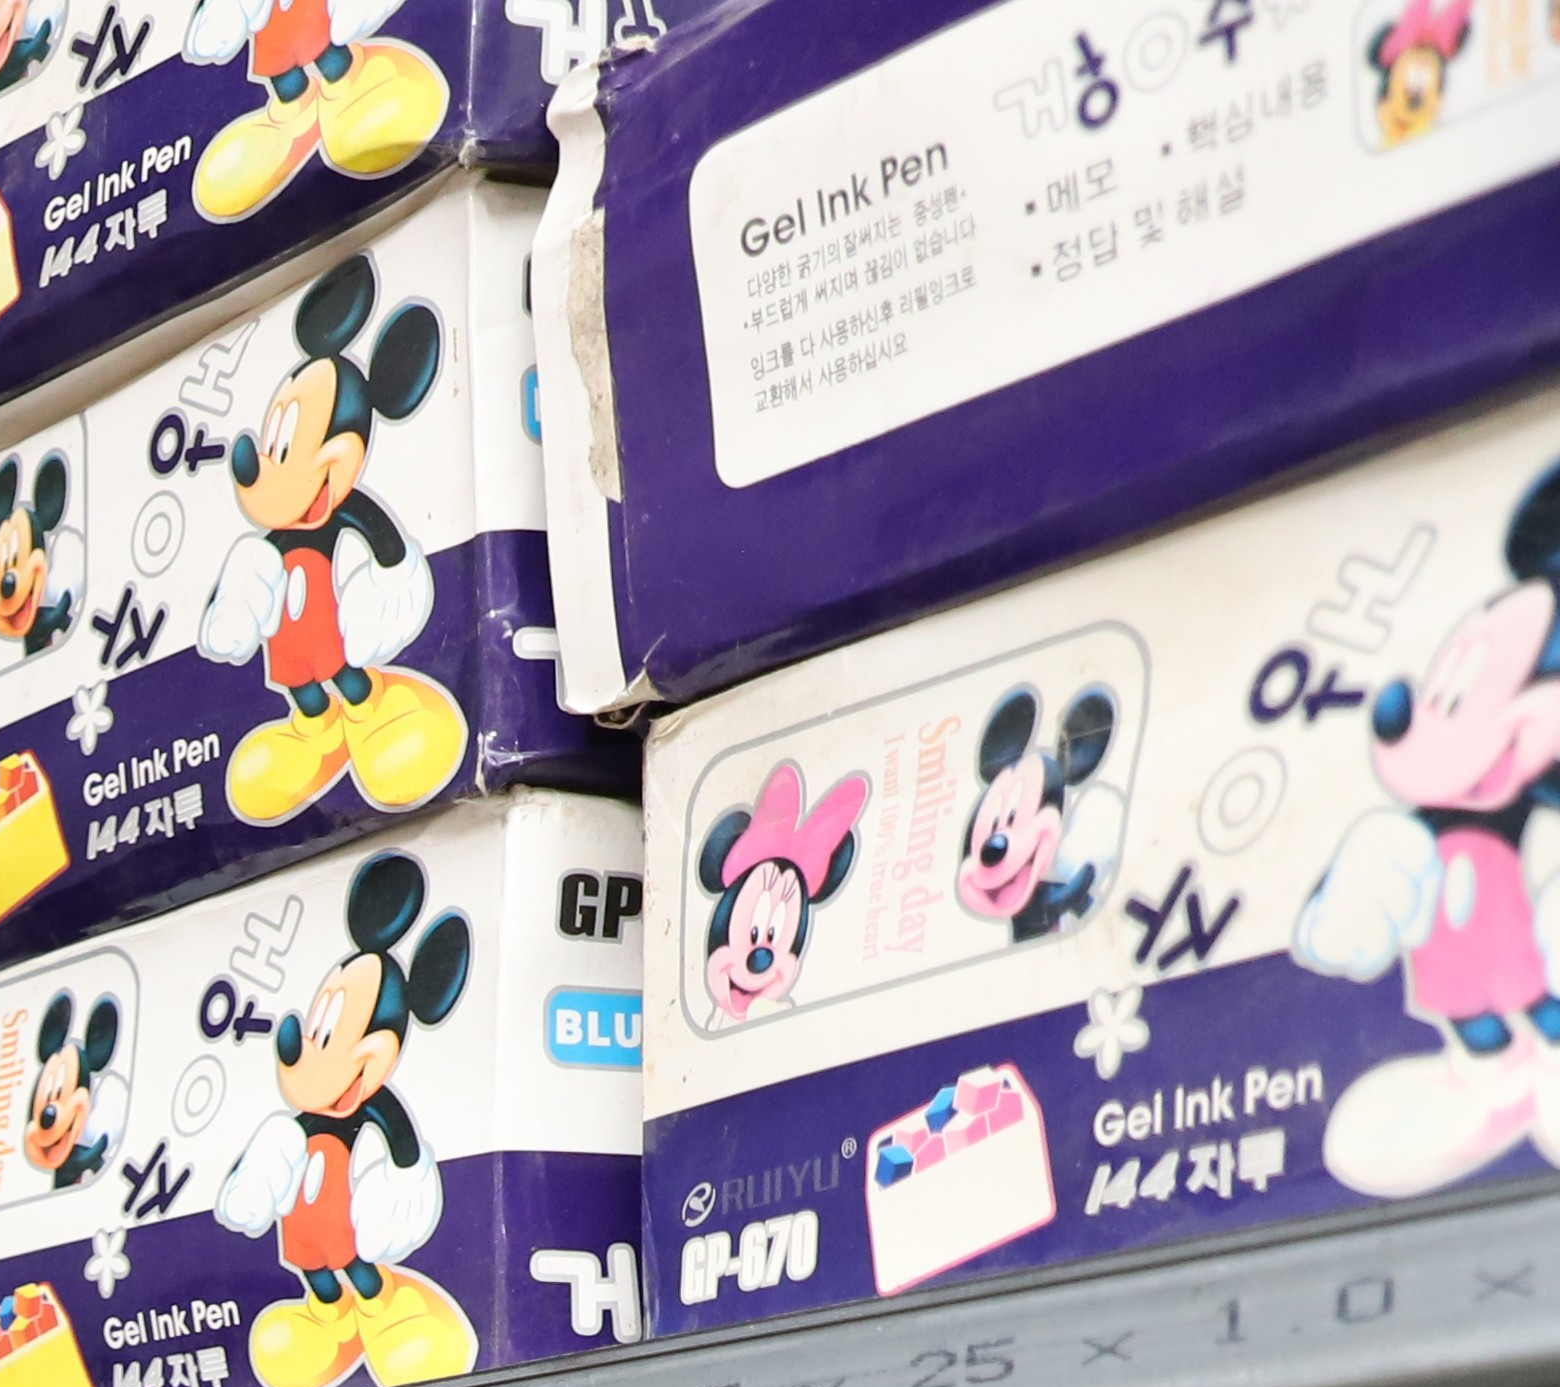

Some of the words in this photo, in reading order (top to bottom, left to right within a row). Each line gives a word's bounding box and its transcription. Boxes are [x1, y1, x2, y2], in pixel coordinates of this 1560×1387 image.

[43, 178, 91, 231] Gel
[96, 162, 136, 209] Ink
[140, 135, 193, 184] Pen
[740, 198, 807, 257] Gel
[818, 173, 872, 227] Ink
[880, 142, 948, 198] Pen
[82, 763, 126, 807] Gel
[131, 747, 169, 791] Ink
[173, 732, 221, 773] Pen
[890, 714, 963, 883] Smiling
[86, 807, 141, 861] 144
[883, 885, 945, 955] day
[1093, 1096, 1161, 1147] Gel
[1174, 1082, 1234, 1130] Ink
[1244, 1063, 1323, 1118] Pen
[1084, 1150, 1179, 1216] 144
[680, 1209, 819, 1305] GP-670
[103, 1310, 150, 1350] Gel
[152, 1303, 189, 1338] Ink
[193, 1299, 241, 1333] Pen
